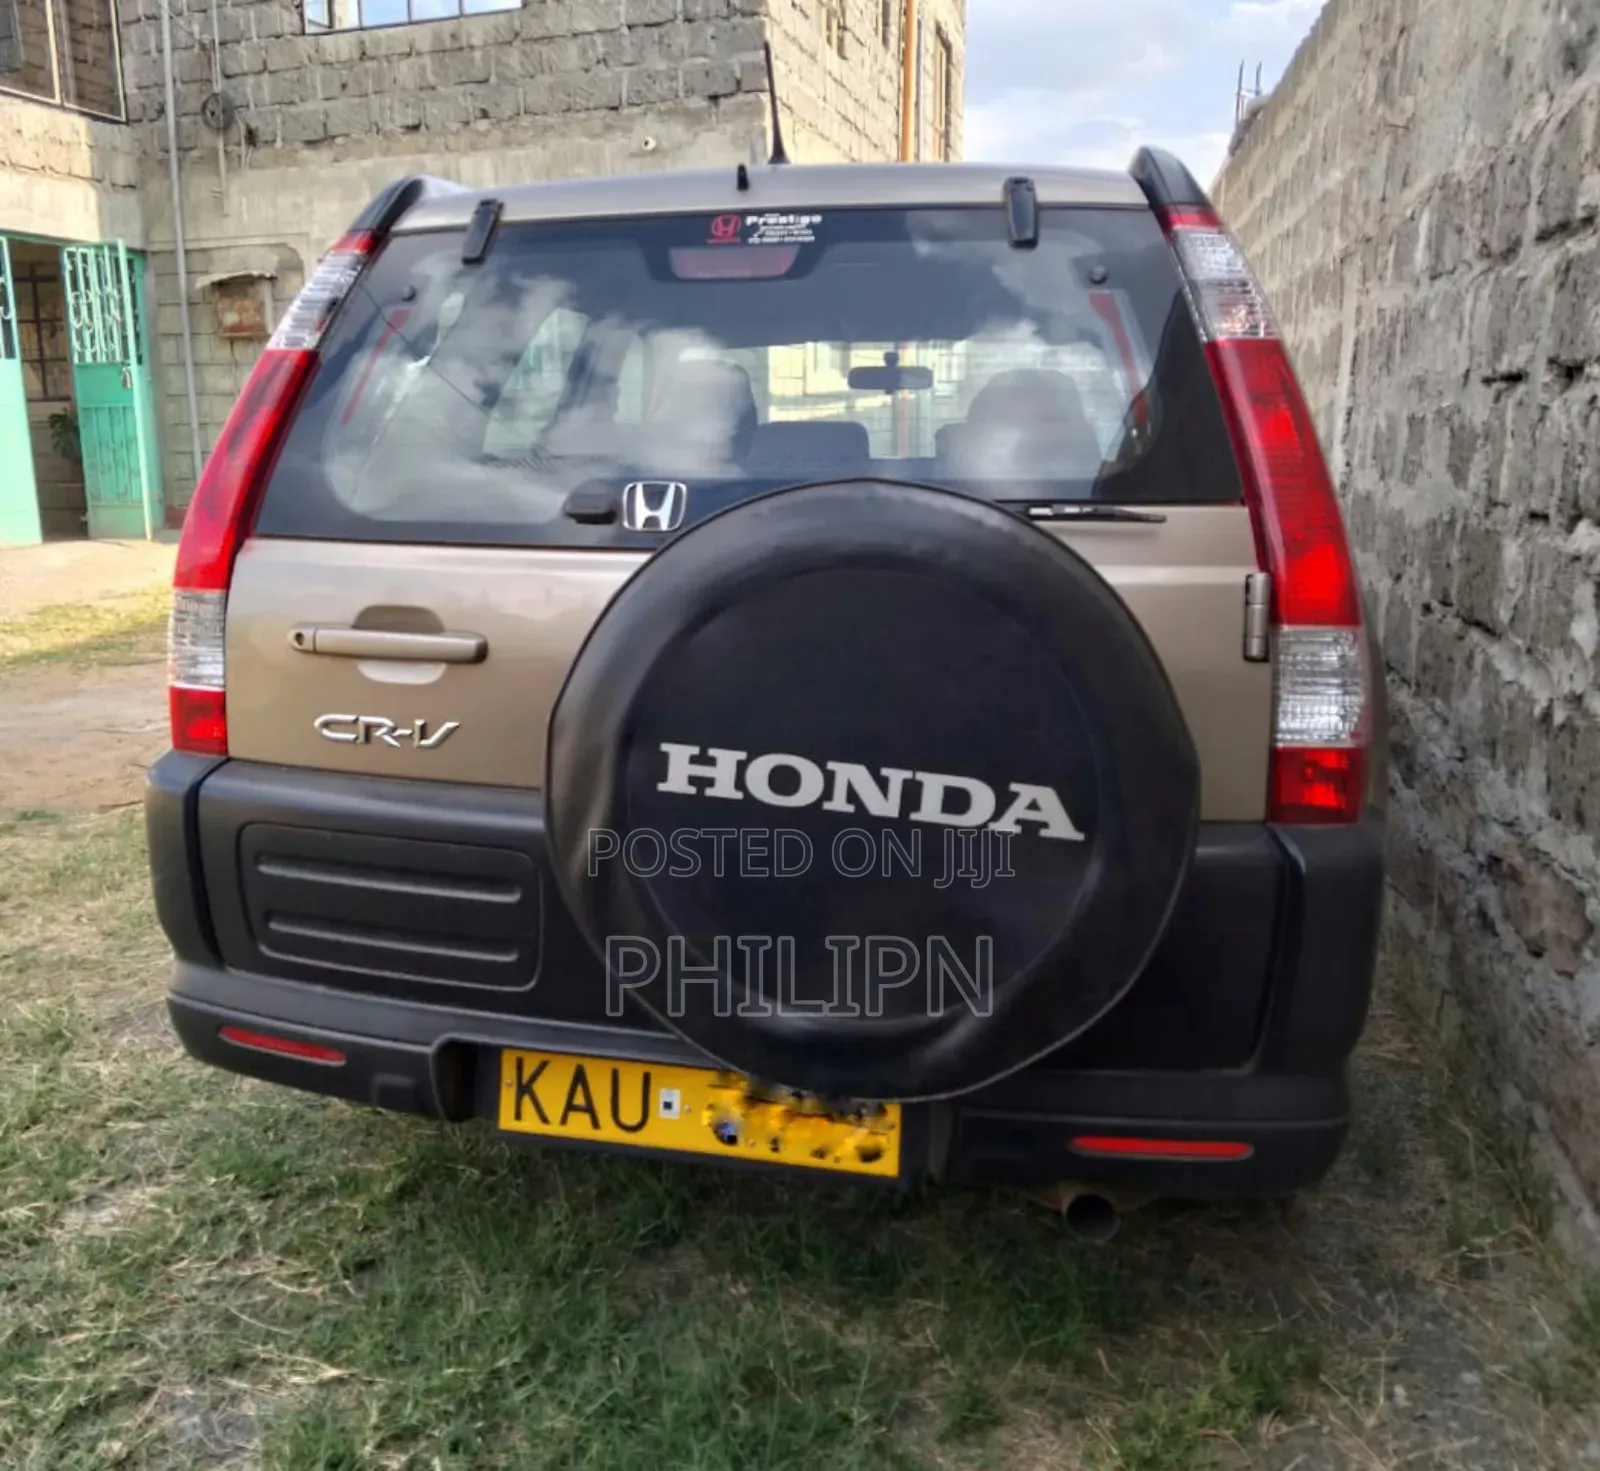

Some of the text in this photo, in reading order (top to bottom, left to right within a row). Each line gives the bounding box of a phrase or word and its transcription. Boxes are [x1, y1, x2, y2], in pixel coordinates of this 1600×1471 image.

[314, 713, 460, 749] CR-V
[657, 743, 1085, 841] HONDA
[513, 1056, 652, 1133] KAU
